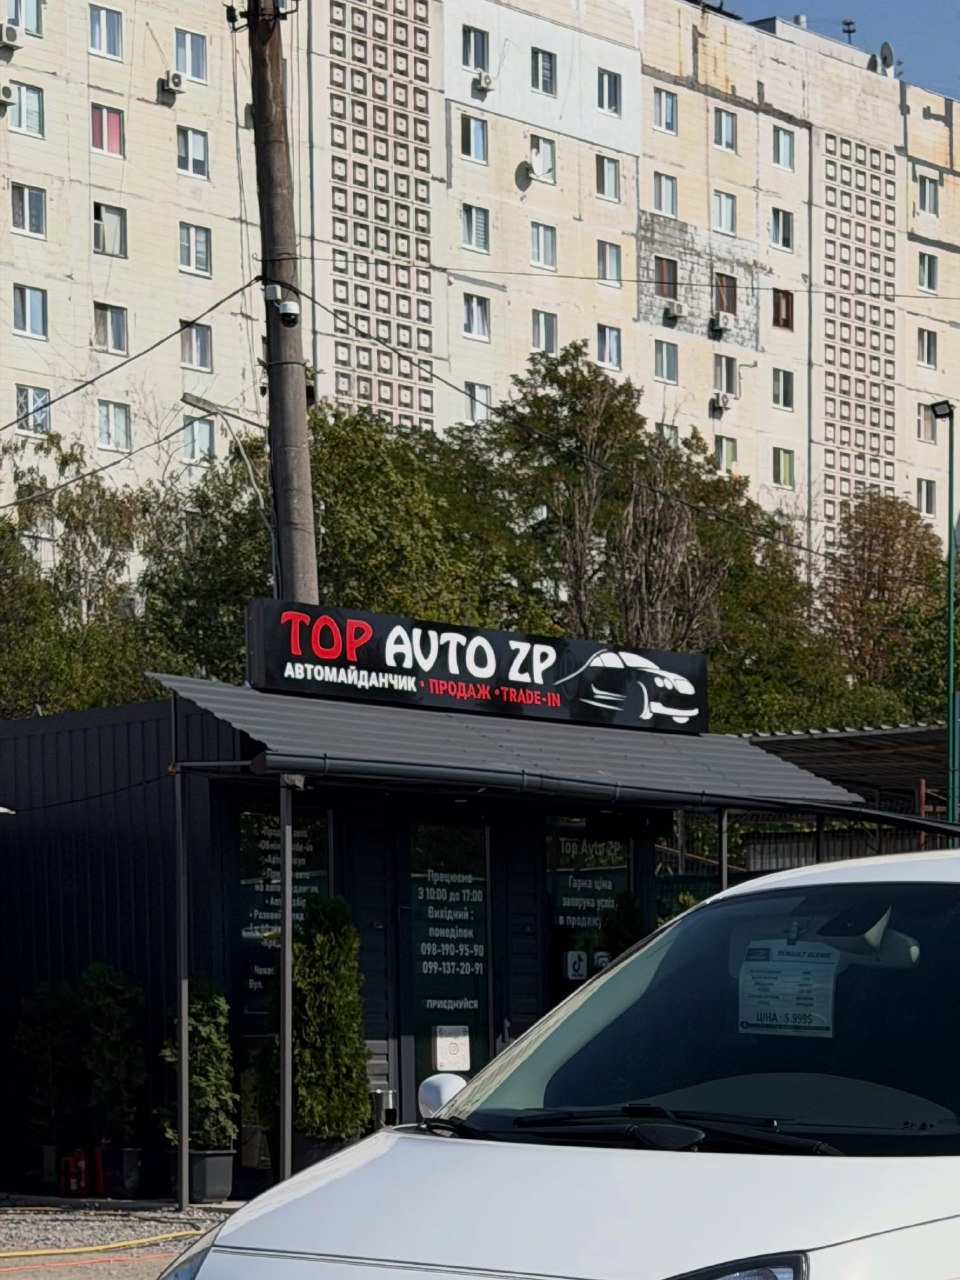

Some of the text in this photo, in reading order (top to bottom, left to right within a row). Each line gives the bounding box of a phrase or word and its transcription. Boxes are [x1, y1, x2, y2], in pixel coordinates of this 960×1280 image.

[281, 611, 373, 661] TOP
[508, 641, 557, 685] ZP
[284, 662, 560, 707] АВТОМАЙДАНЧИК ПРОДАЖ TRADE-IN
[425, 887, 448, 900] 10:00
[449, 891, 460, 903] до
[461, 889, 483, 902] 17:00
[427, 905, 469, 921] Вихідний
[428, 926, 474, 939] понеділок
[422, 960, 484, 975] 099-137-20-91
[426, 997, 479, 1010] ПРИЄДНУЙСЯ
